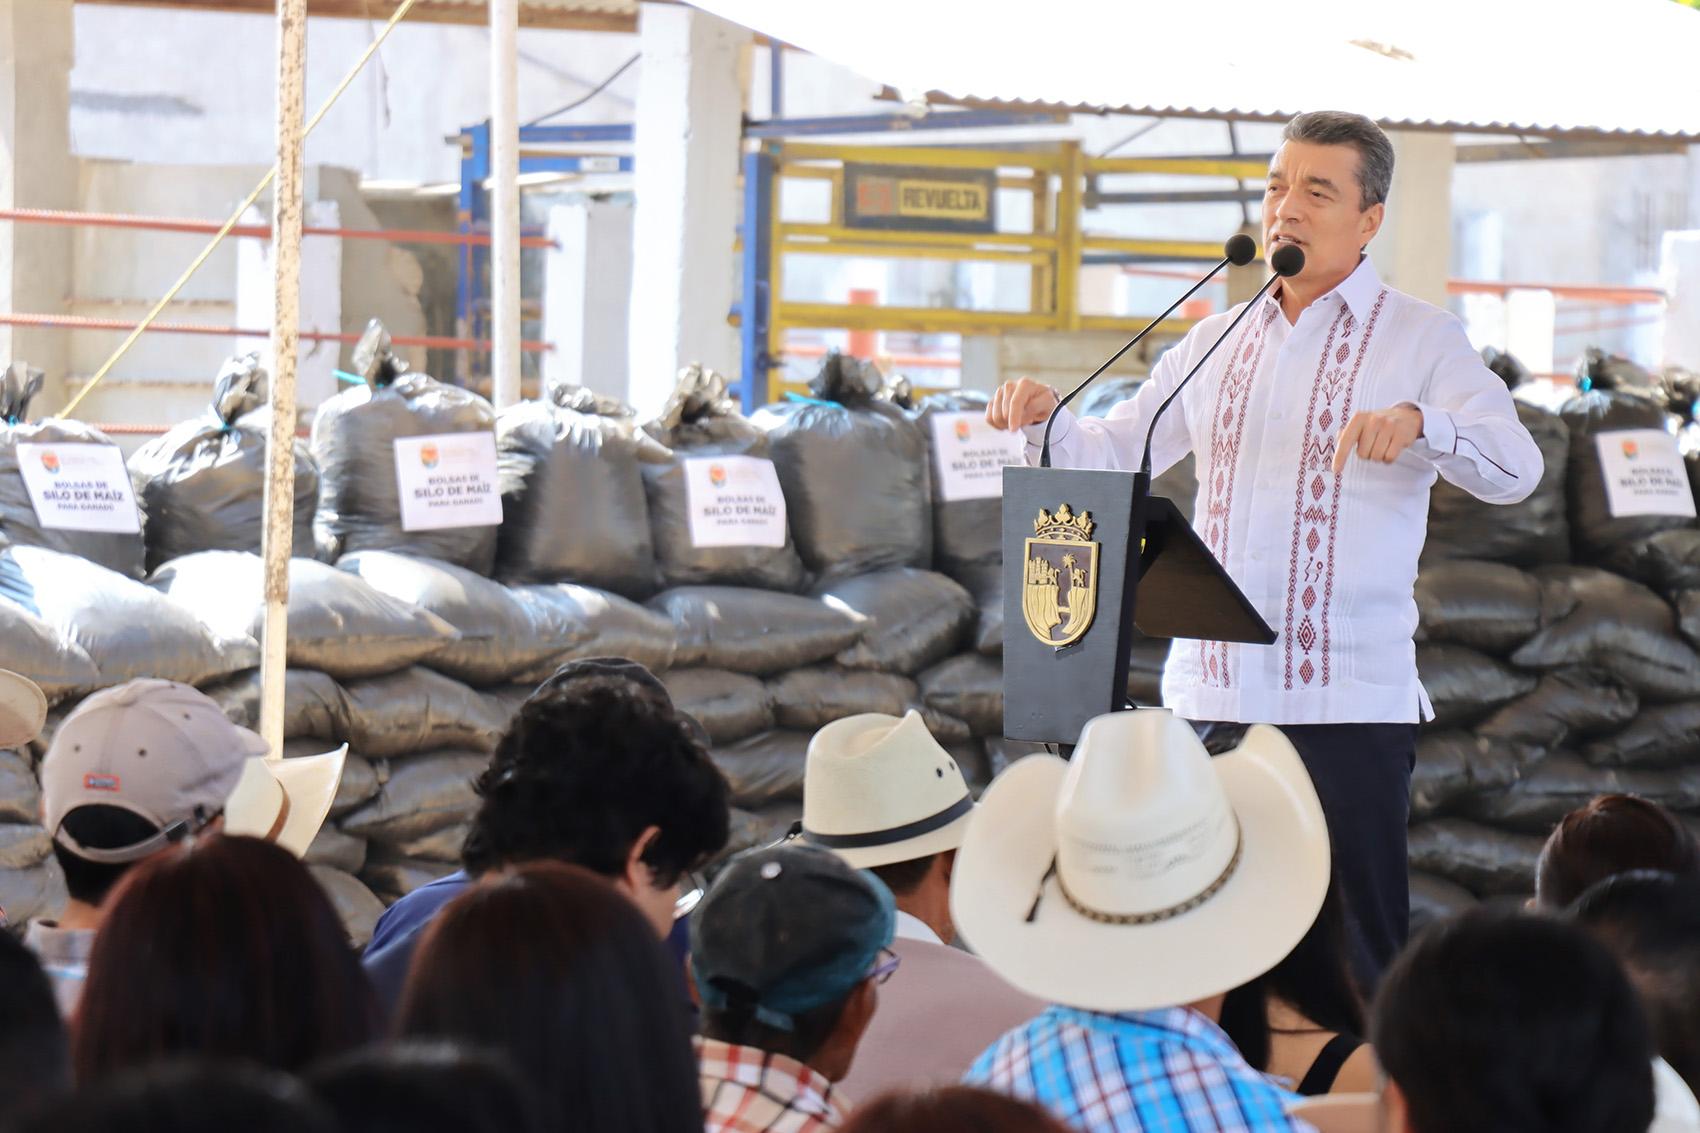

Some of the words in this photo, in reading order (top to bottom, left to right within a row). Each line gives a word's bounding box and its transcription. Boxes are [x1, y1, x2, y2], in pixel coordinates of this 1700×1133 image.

[903, 187, 981, 211] REVUELTA
[43, 490, 71, 500] SILO
[74, 491, 90, 500] DE
[414, 487, 444, 498] SILO
[447, 486, 463, 495] DE
